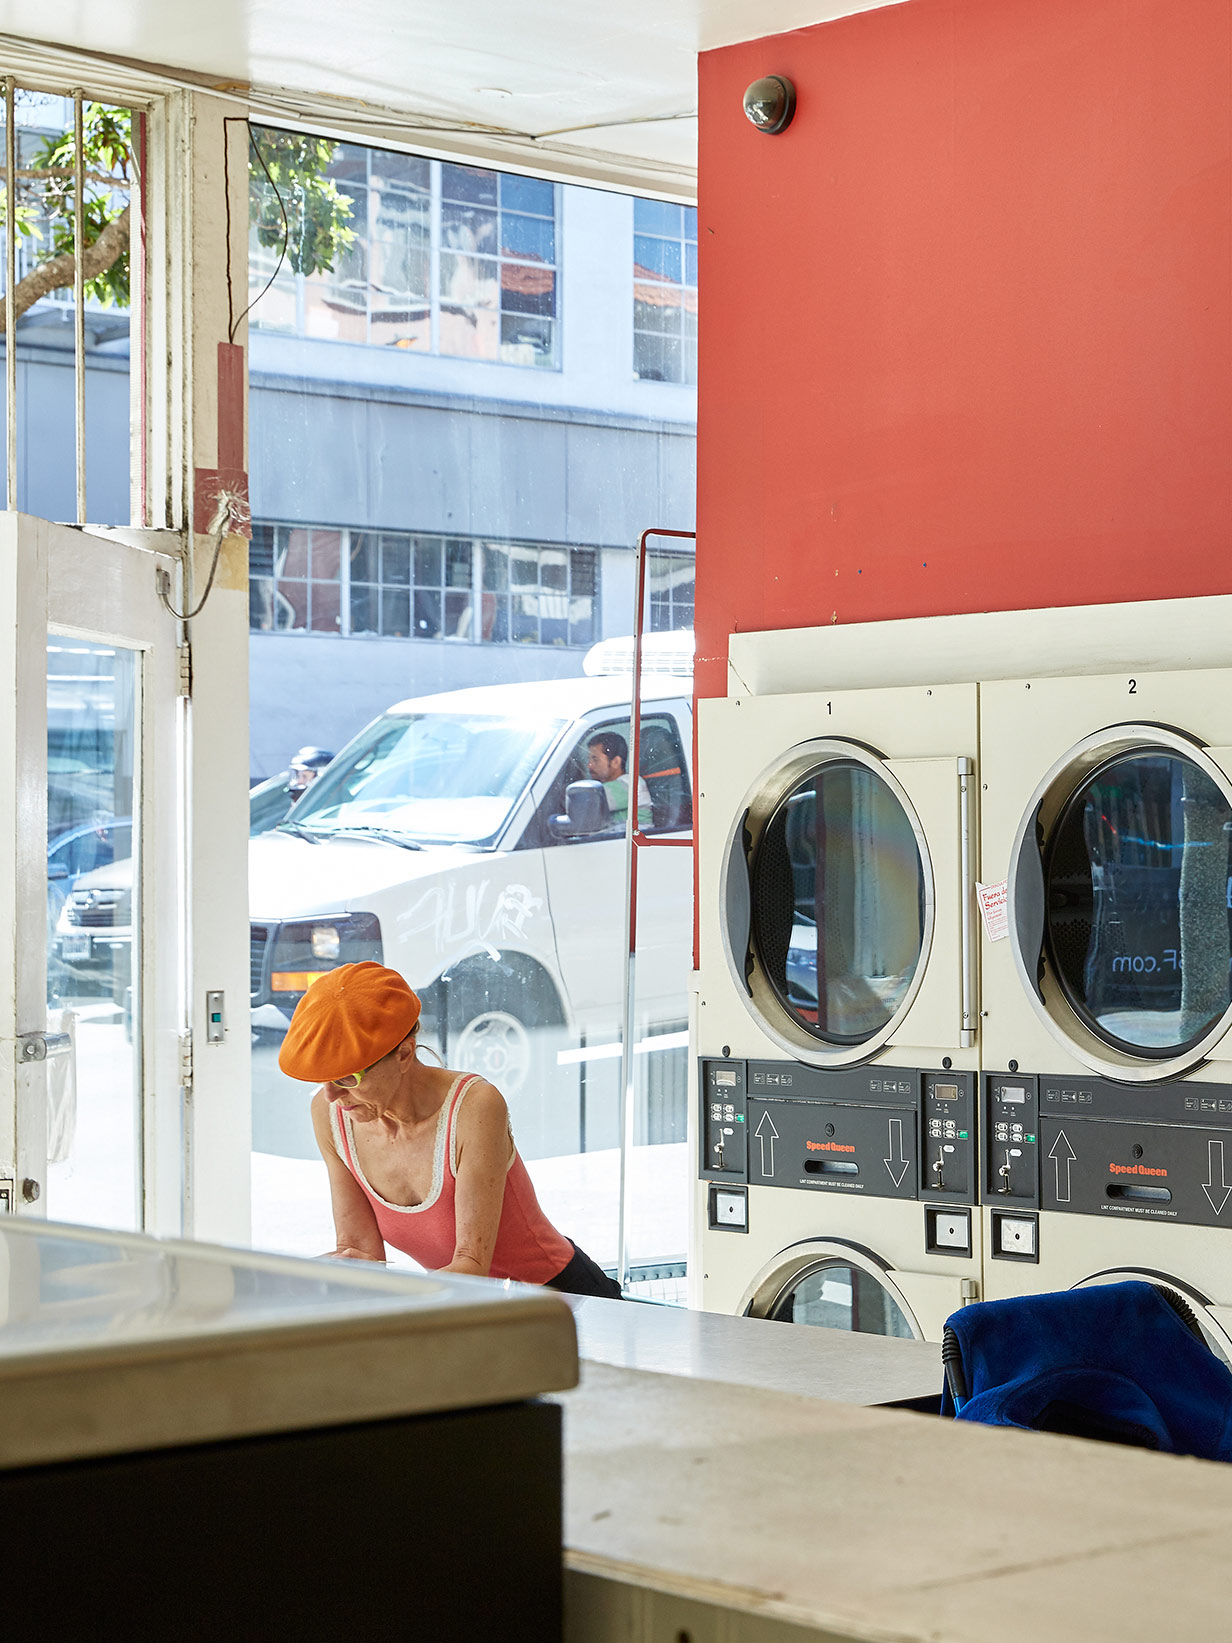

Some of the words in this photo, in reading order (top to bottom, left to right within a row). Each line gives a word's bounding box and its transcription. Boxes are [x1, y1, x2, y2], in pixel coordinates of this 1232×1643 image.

[1128, 678, 1137, 694] 2
[826, 701, 832, 715] 1
[984, 896, 1007, 910] Servici
[806, 1140, 831, 1151] Speed
[831, 1142, 855, 1153] Queen
[1109, 1162, 1138, 1175] Speed
[1138, 1165, 1168, 1177] Queen
